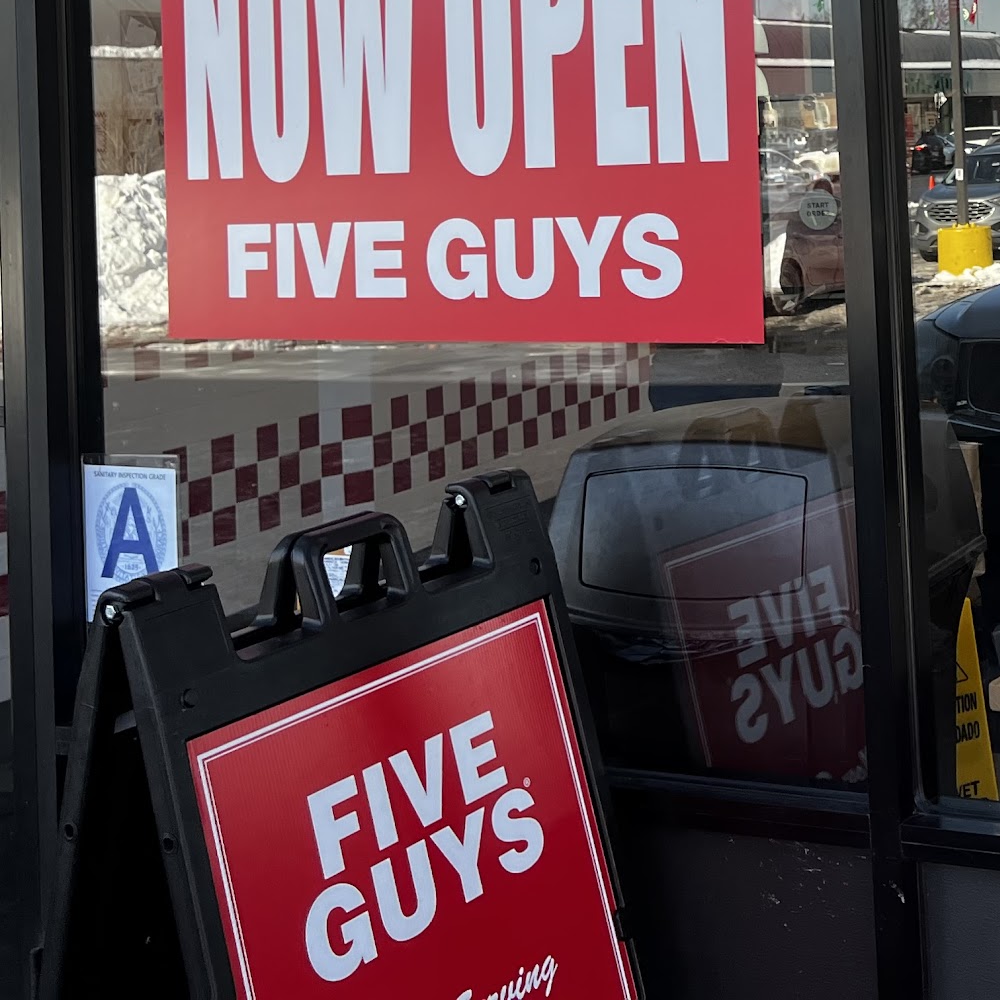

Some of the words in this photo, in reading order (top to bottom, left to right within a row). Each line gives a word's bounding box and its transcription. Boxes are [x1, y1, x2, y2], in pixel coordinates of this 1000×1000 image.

[226, 221, 407, 299] FIVE
[426, 213, 684, 300] GUYS
[93, 470, 118, 478] SANITARY
[118, 471, 148, 480] INSPECTION
[148, 473, 167, 481] GRADE
[101, 487, 160, 579] A
[955, 691, 978, 714] TION
[955, 720, 981, 744] DADO
[306, 710, 509, 881] FIVE
[958, 780, 981, 799] ET
[304, 787, 545, 982] GUYS
